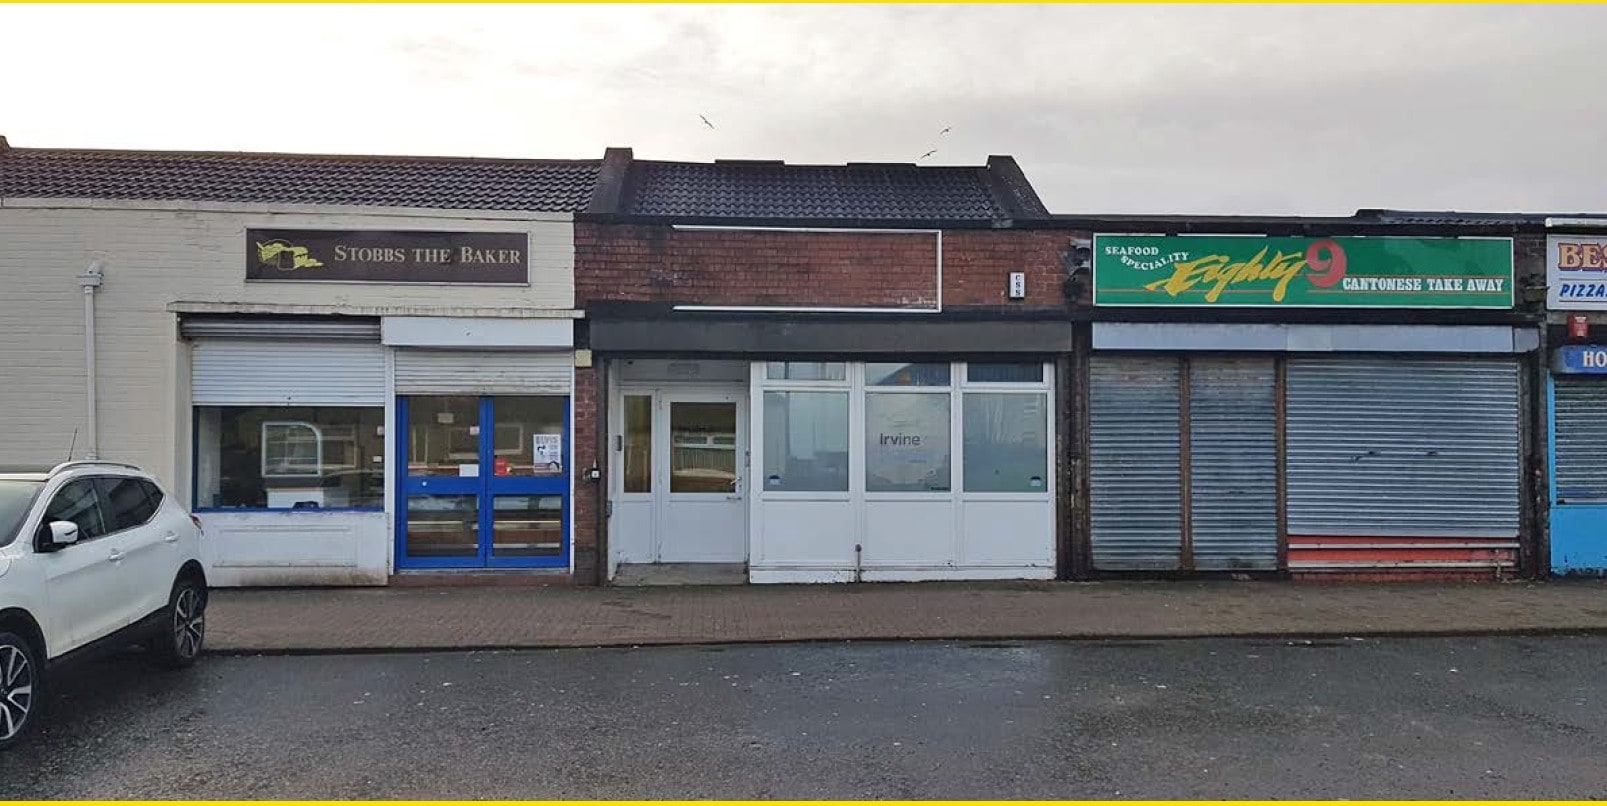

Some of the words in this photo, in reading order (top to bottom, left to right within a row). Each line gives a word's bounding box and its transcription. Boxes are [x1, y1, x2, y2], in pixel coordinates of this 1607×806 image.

[334, 244, 405, 263] STOBBS
[411, 248, 452, 263] THE
[461, 246, 521, 264] BAKER
[1104, 246, 1160, 257] SEAFOOD
[1120, 251, 1190, 271] SPECIALITY
[1143, 244, 1307, 303] Eighty
[1305, 239, 1348, 288] 9
[1342, 277, 1422, 292] CANTONESE
[1427, 278, 1463, 292] TAKE
[1466, 278, 1505, 292] AWAY
[1559, 284, 1607, 298] PIZZA
[879, 432, 922, 446] Irvine
